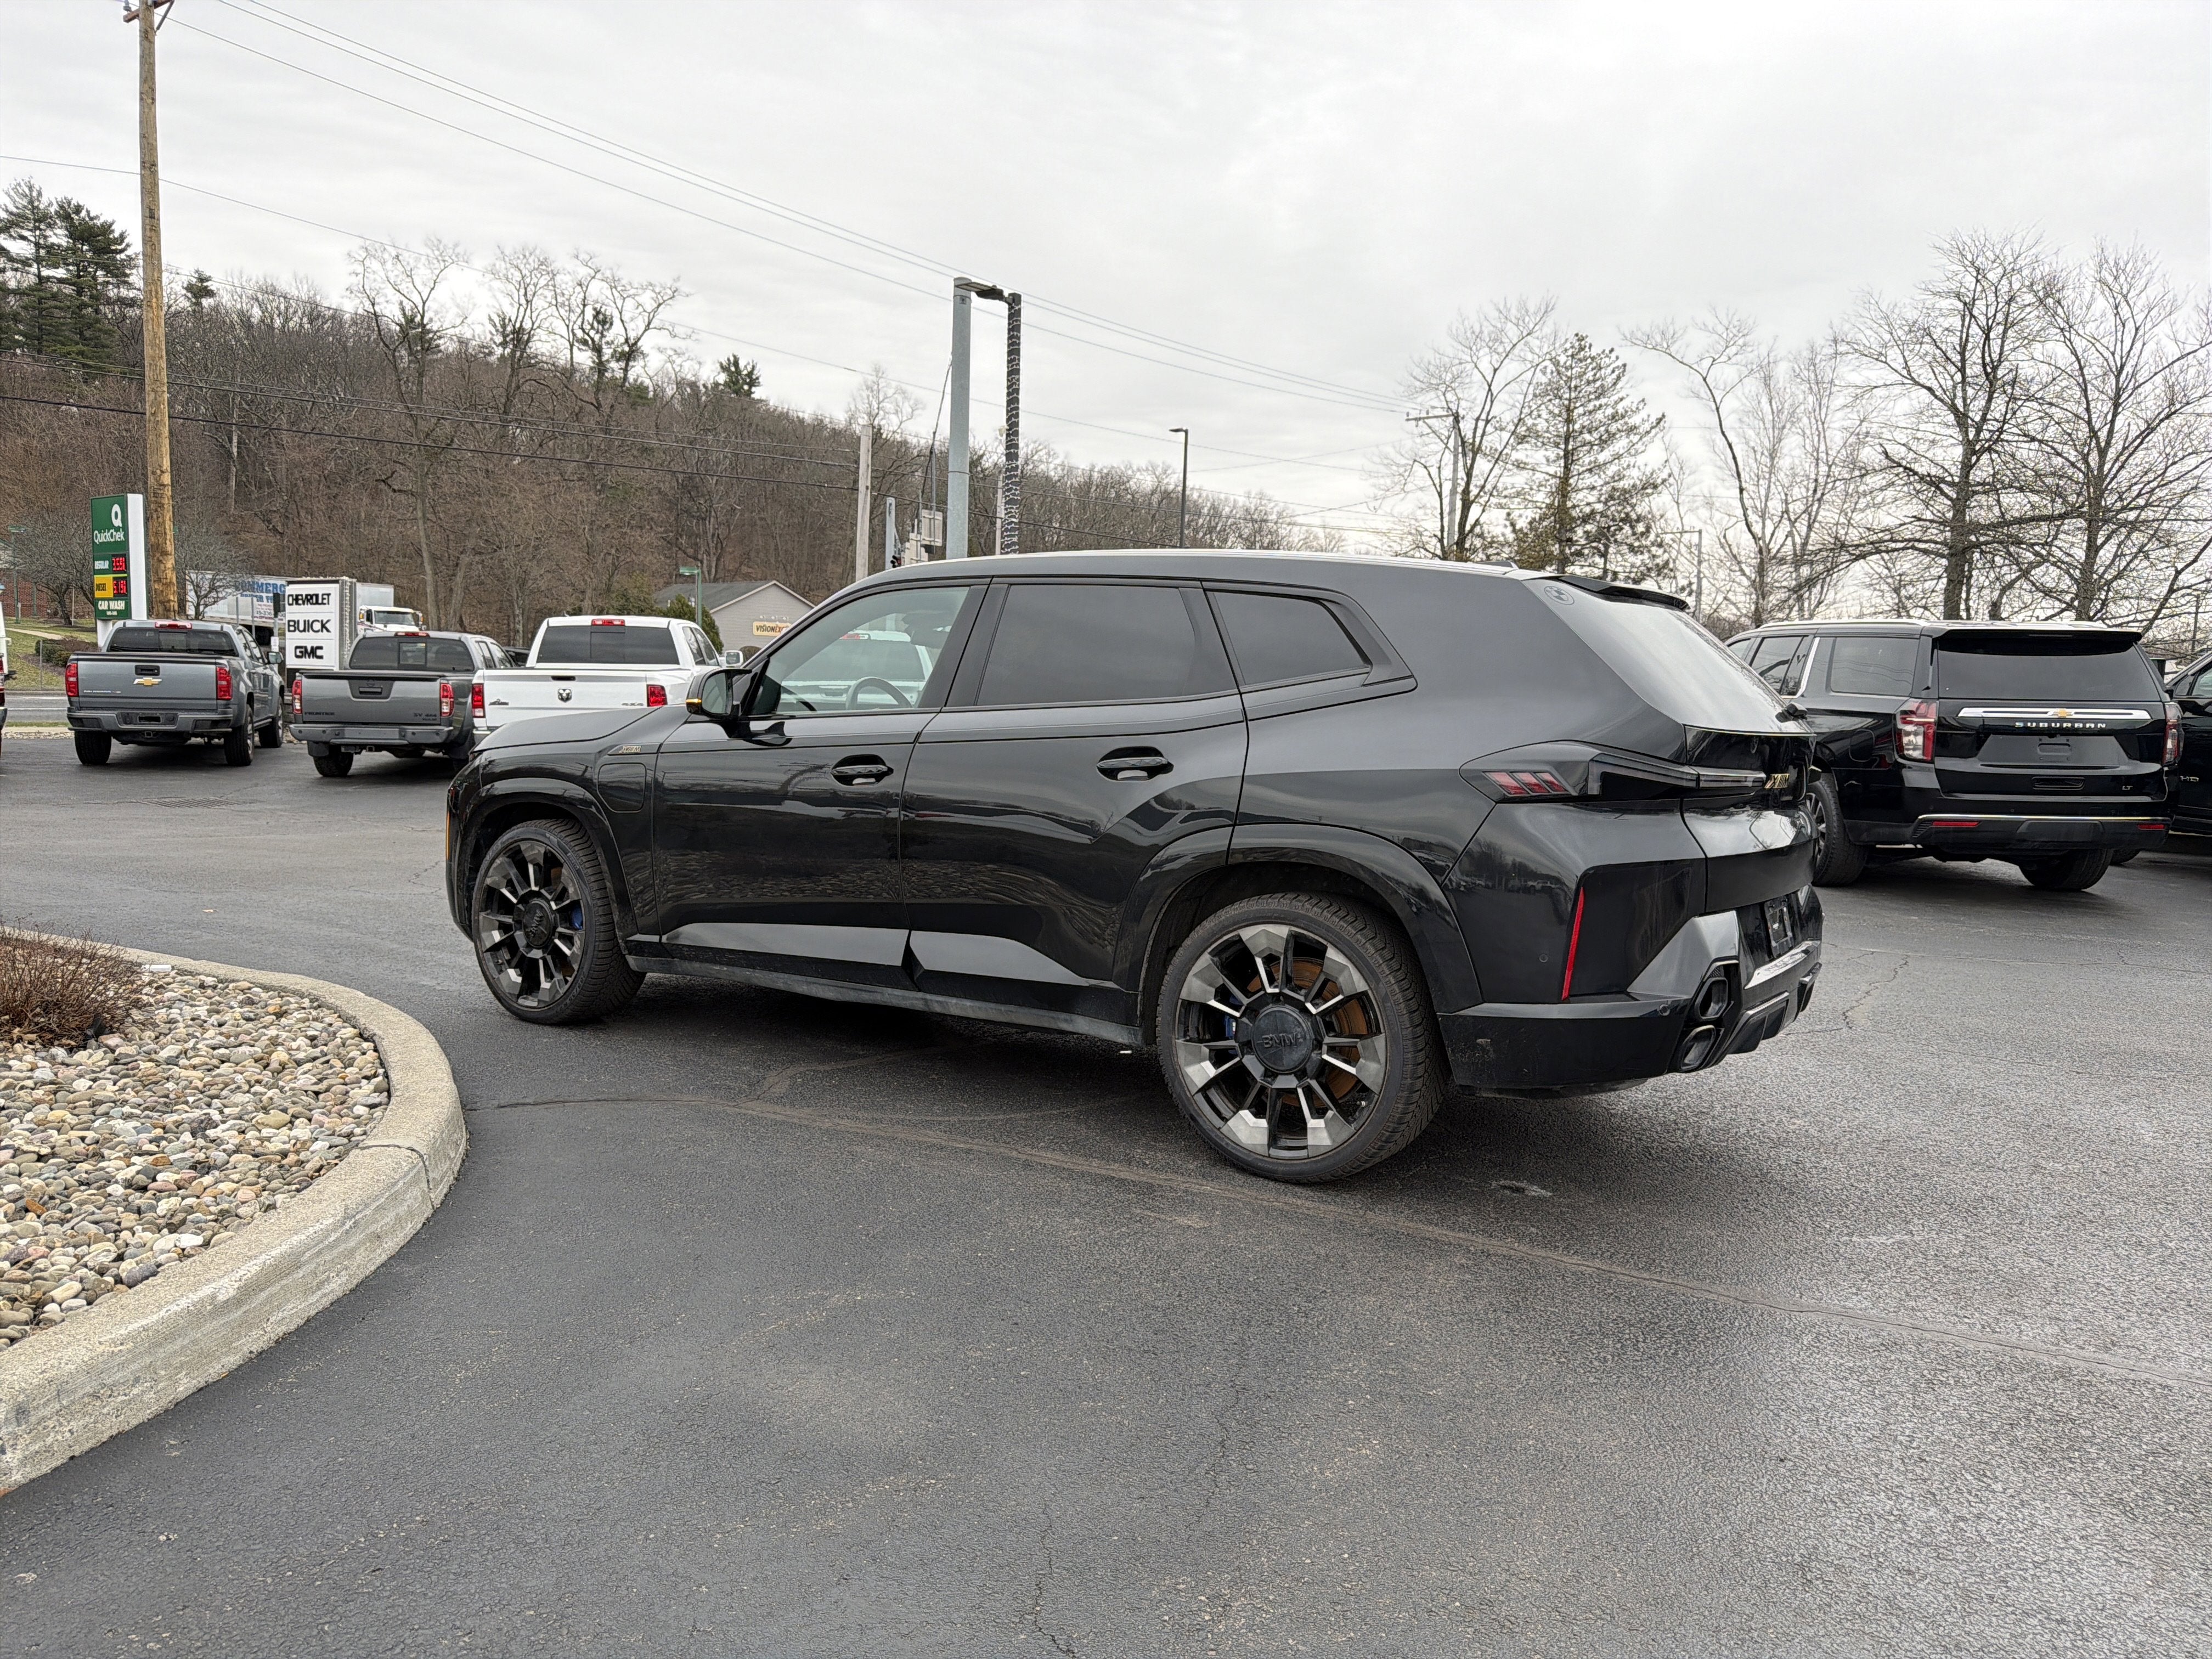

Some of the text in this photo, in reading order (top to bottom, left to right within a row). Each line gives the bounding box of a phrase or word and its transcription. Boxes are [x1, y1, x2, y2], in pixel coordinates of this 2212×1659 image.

[111, 504, 122, 527] Q
[93, 528, 125, 544] QuickChek
[95, 583, 107, 591] DIESEL
[98, 600, 125, 610] CAR WASH
[287, 593, 331, 606] CHEVROLET
[287, 619, 332, 633] BUICK
[294, 645, 324, 659] GMC
[1262, 1032, 1298, 1048] BMW
